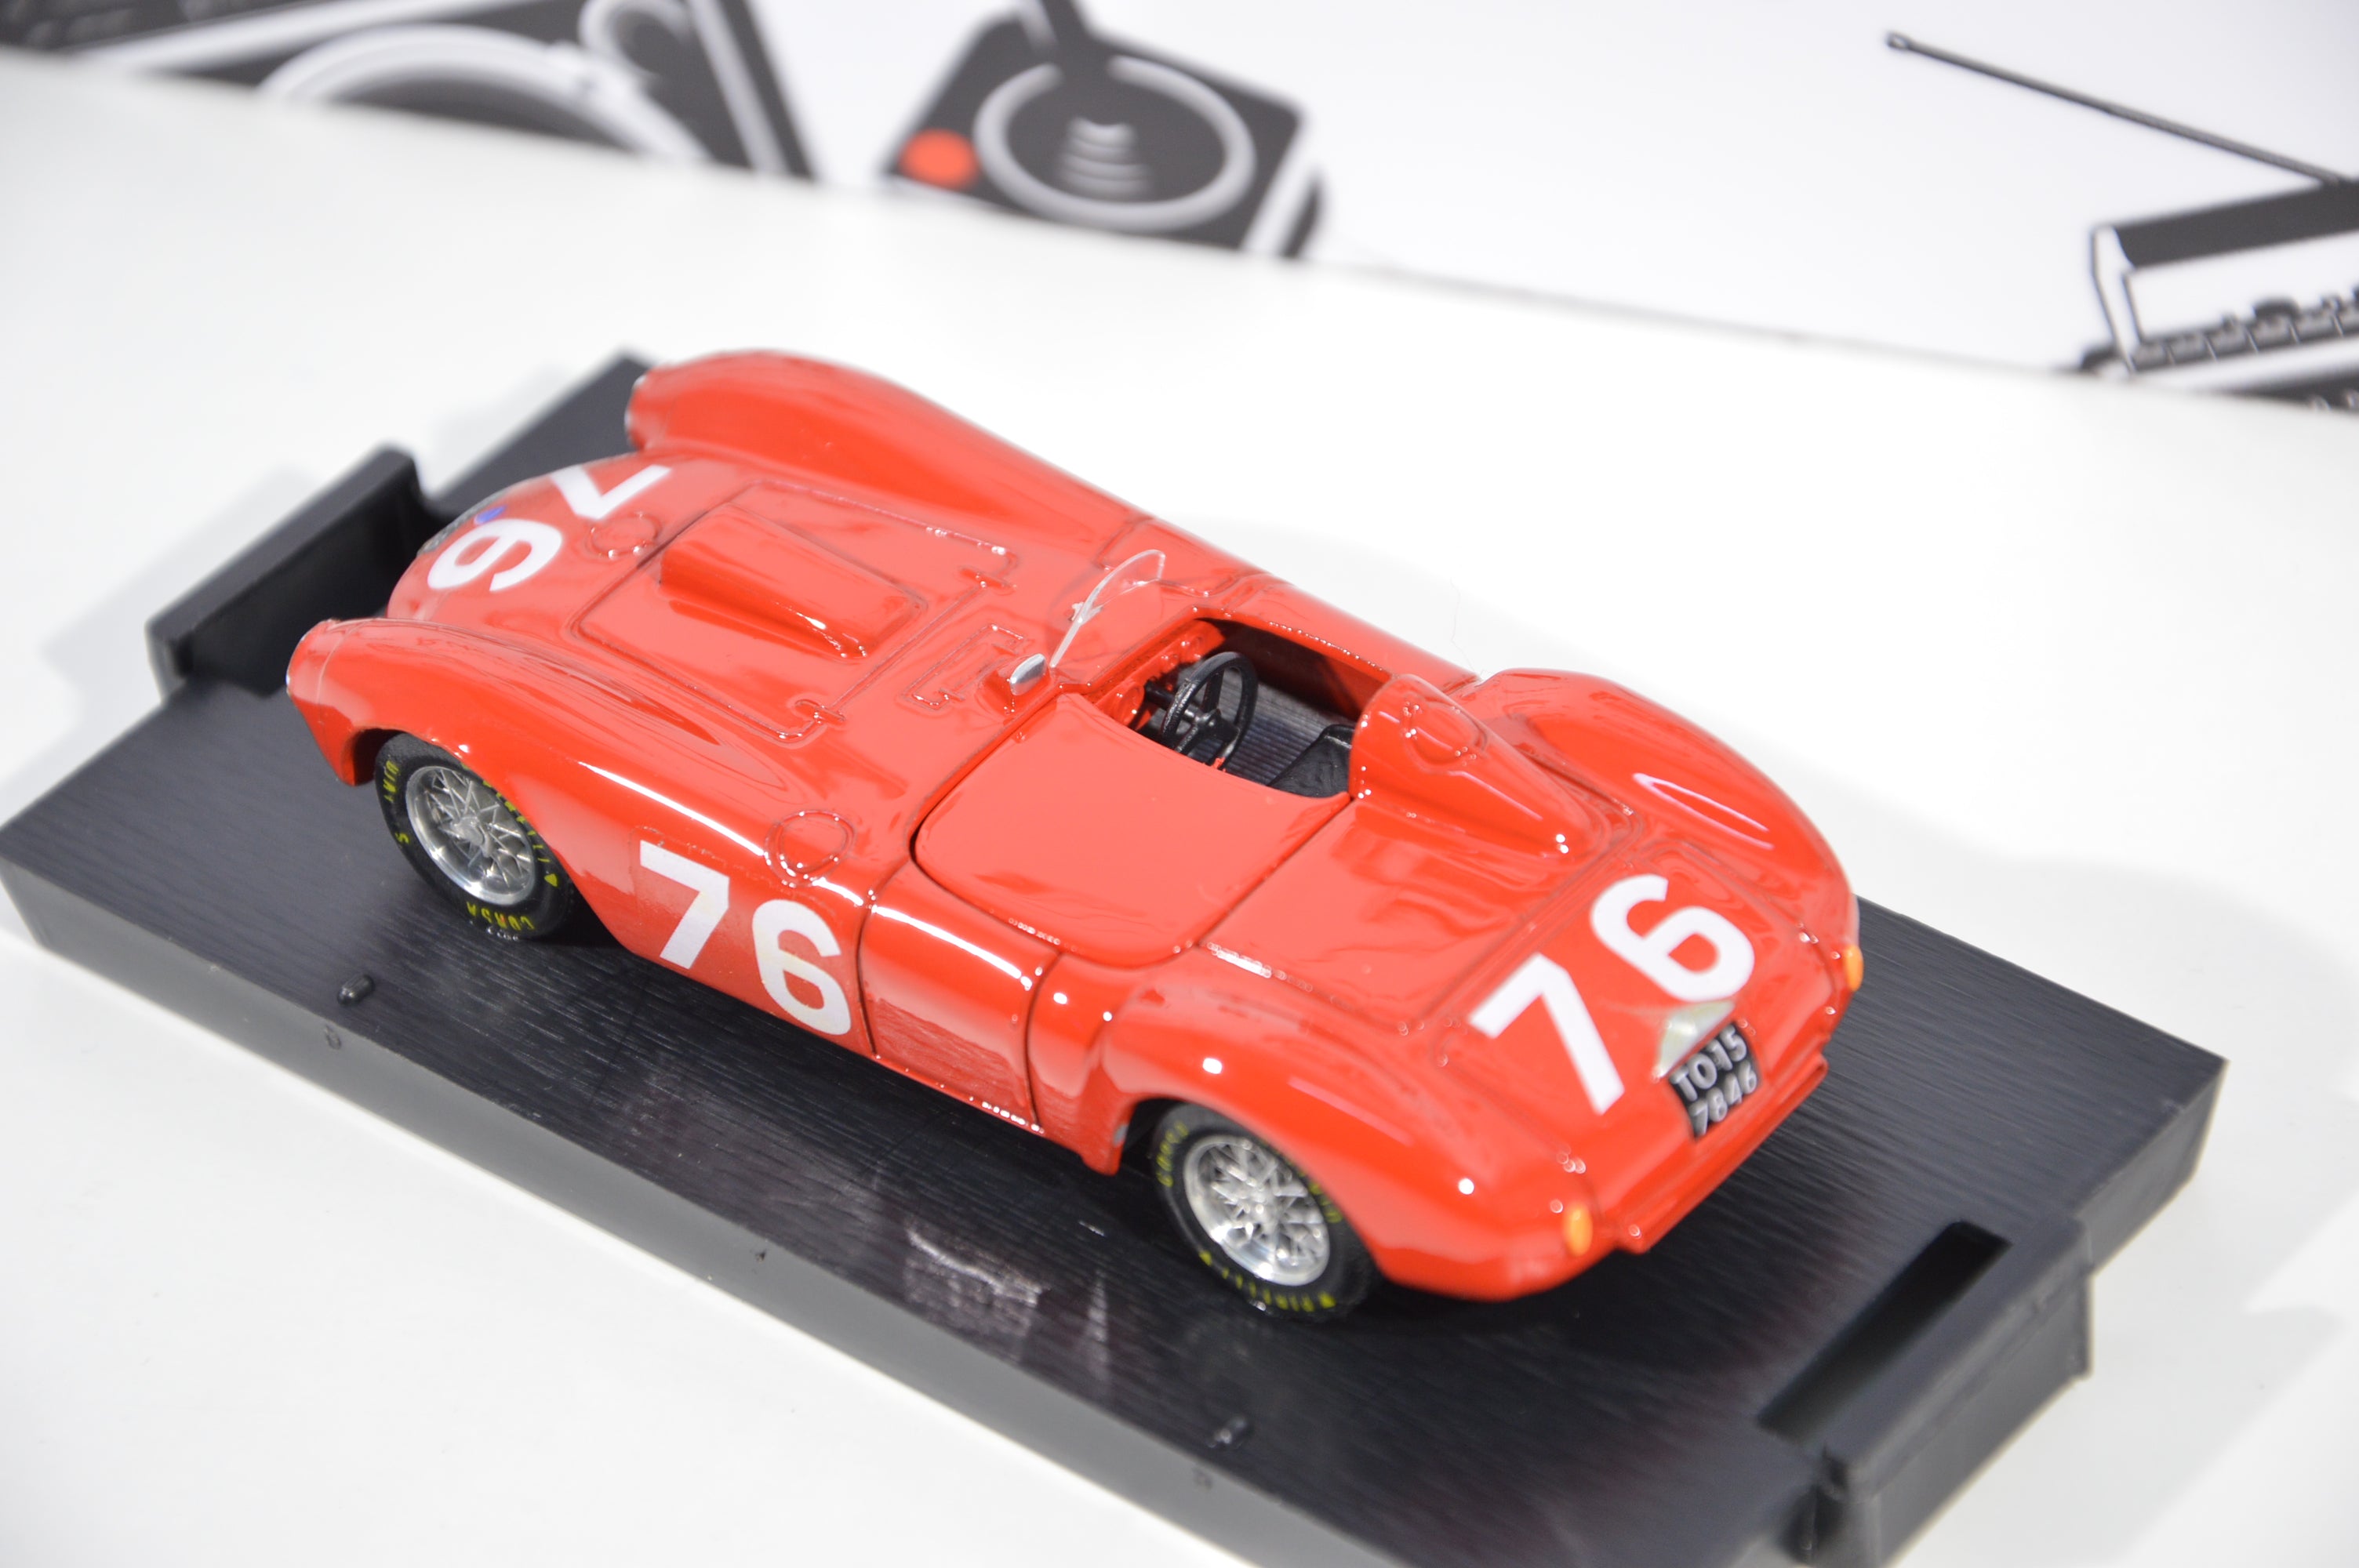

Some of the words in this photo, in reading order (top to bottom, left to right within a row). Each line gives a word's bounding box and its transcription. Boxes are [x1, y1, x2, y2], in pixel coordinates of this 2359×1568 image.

[427, 464, 671, 592] 76
[640, 840, 852, 1036] 76
[1468, 873, 1755, 1116] 76
[1688, 1060, 1757, 1136] 7846
